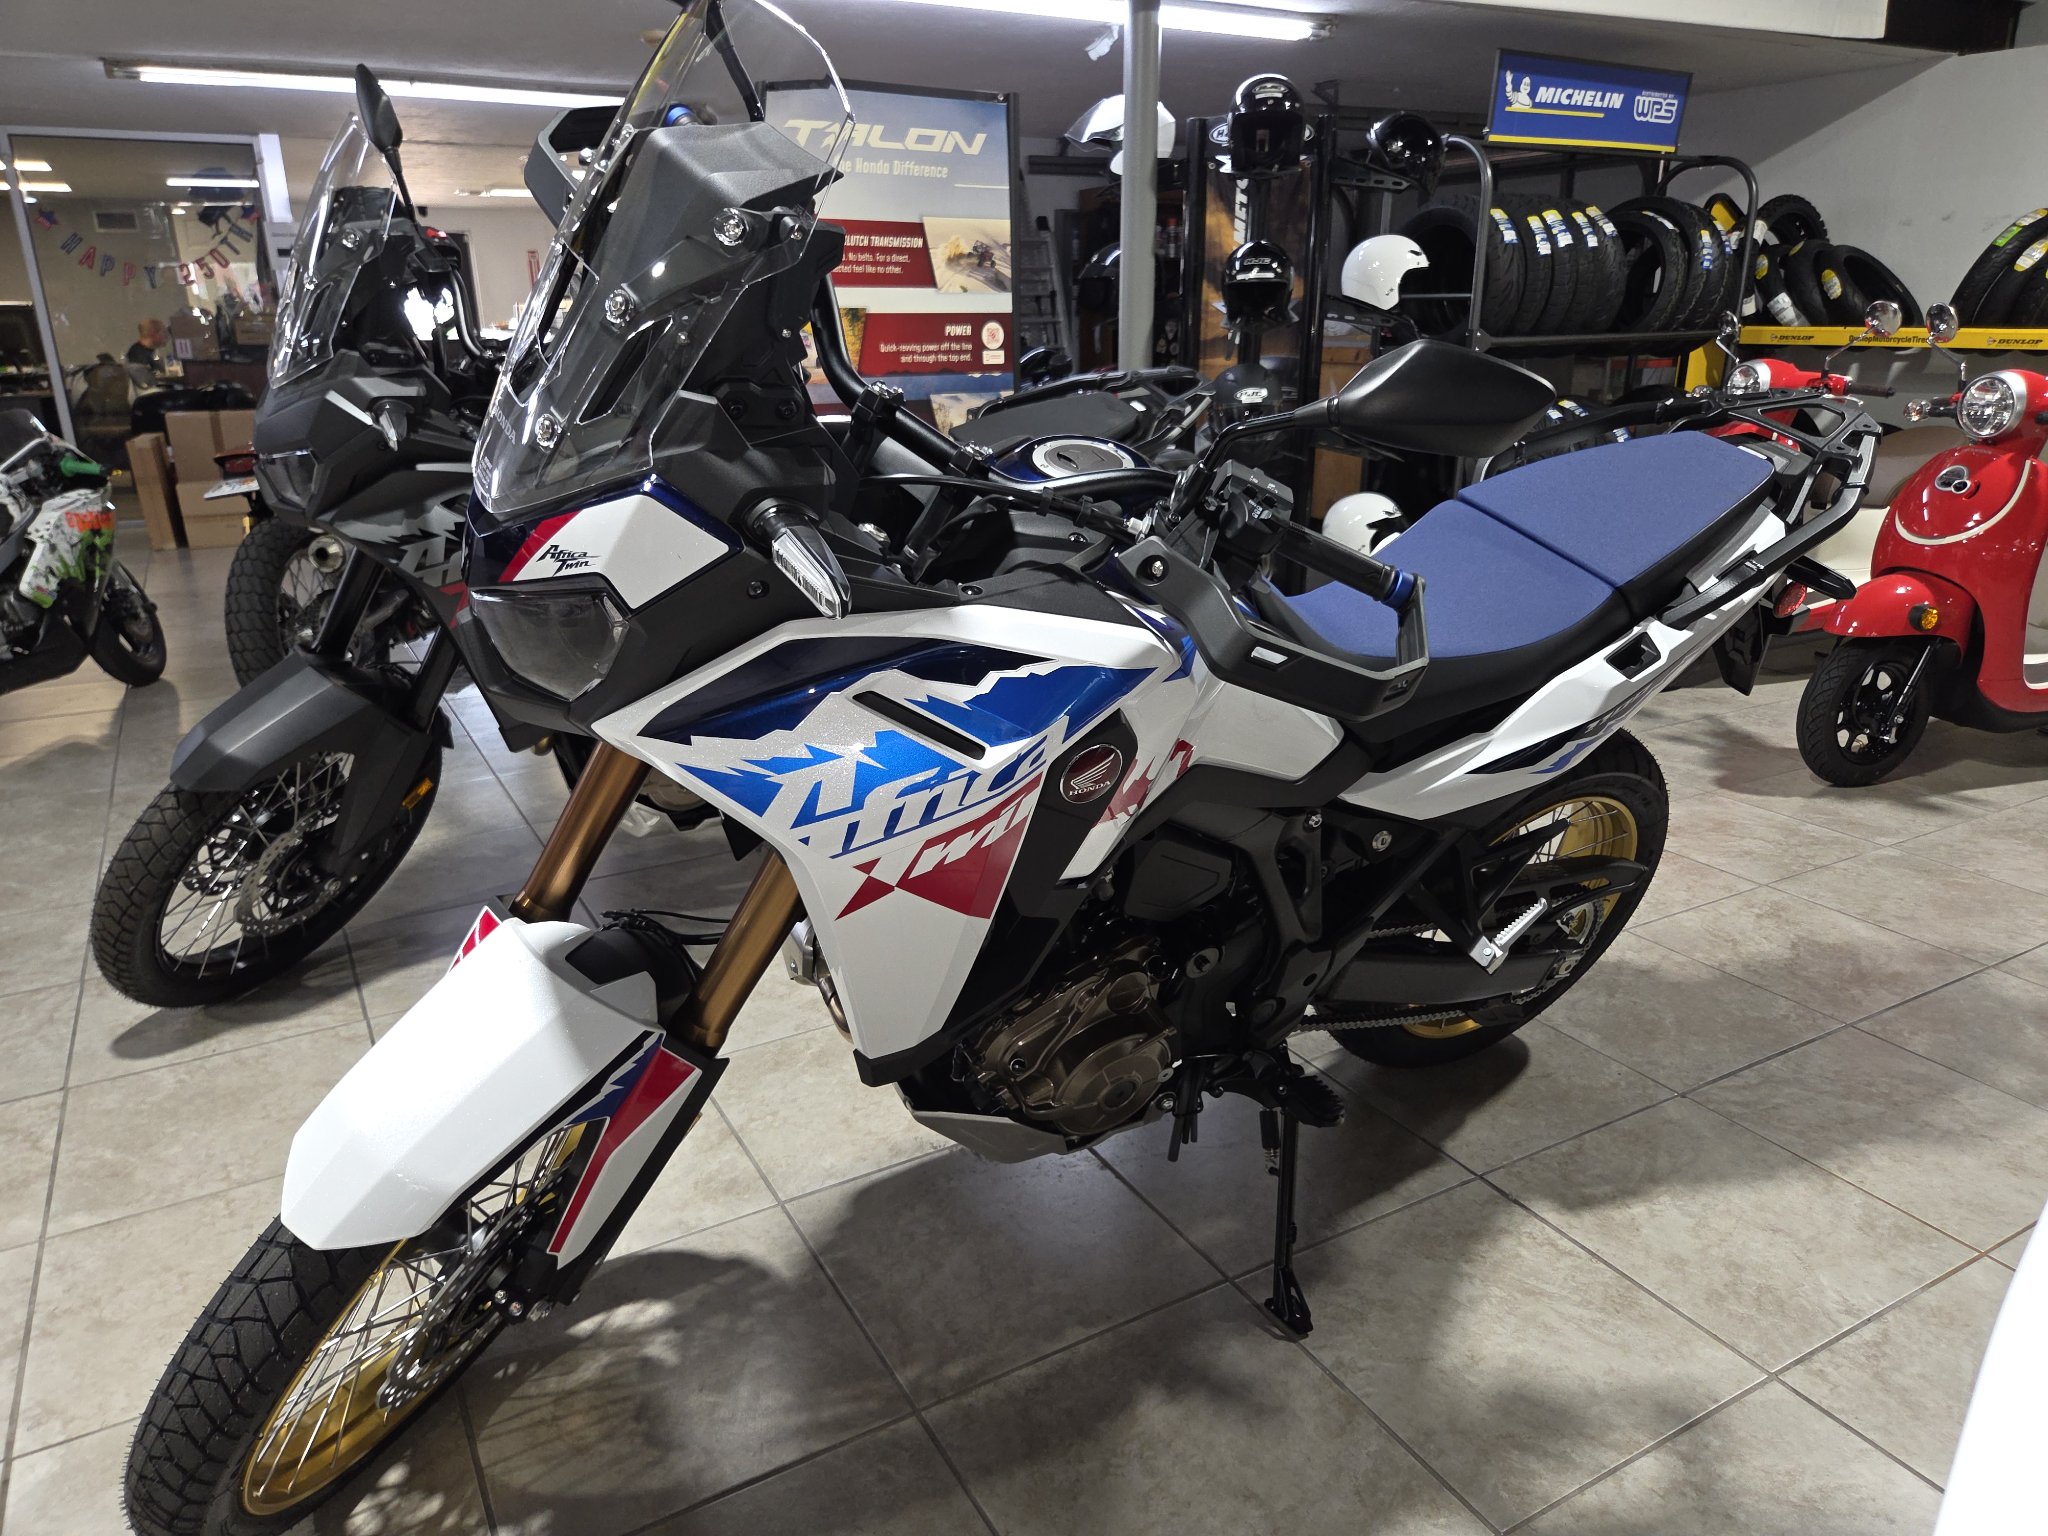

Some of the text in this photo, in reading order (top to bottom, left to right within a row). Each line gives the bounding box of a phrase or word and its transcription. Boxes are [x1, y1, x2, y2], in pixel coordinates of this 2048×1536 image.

[1535, 87, 1624, 109] MICHELIN
[1634, 96, 1678, 124] WPS
[785, 119, 987, 155] TALON
[856, 158, 890, 175] Honda
[893, 160, 949, 178] Difference
[870, 236, 923, 249] TRANSMISSION
[61, 232, 158, 289] HAPPY
[945, 325, 972, 337] POWER
[922, 344, 939, 353] power
[950, 342, 960, 351] the
[937, 353, 947, 362] the
[536, 545, 598, 562] Africa
[552, 559, 595, 577] Twin
[1069, 781, 1110, 796] HONDA
